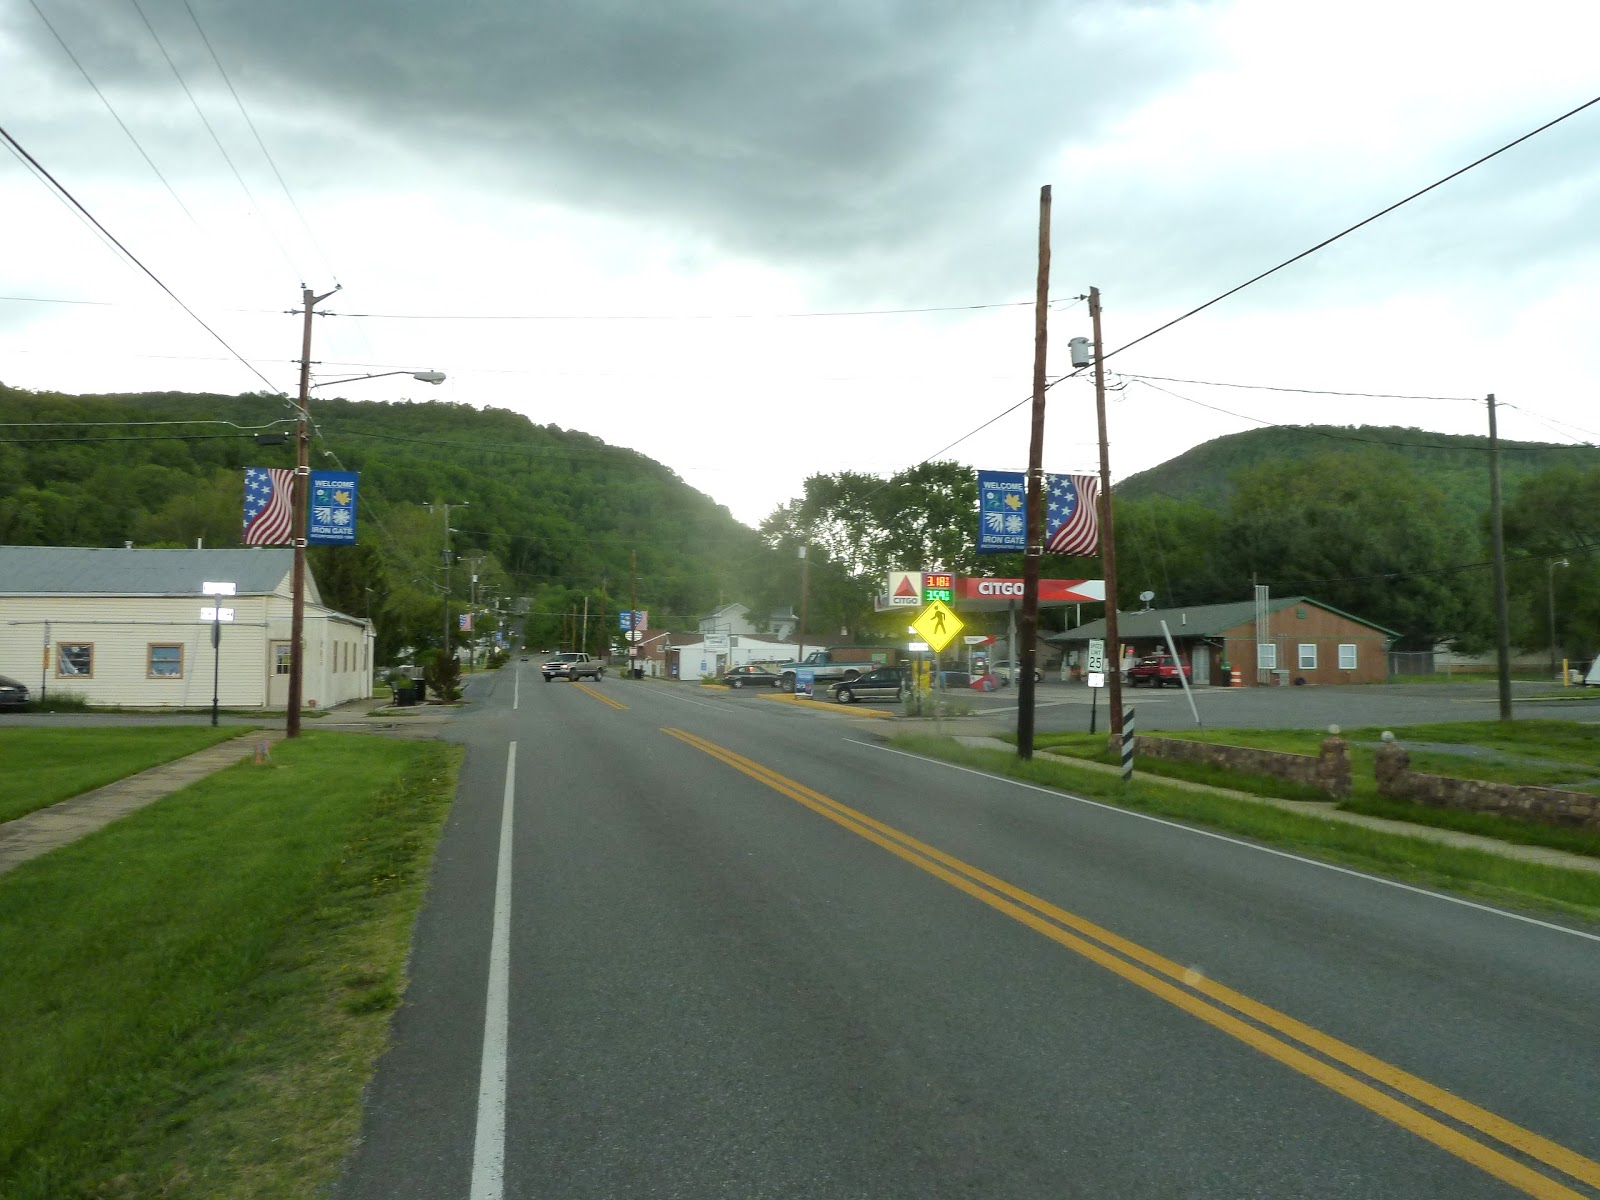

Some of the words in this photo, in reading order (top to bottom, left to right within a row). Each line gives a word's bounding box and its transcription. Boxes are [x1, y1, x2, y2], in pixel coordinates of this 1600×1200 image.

[314, 480, 355, 488] WELCOME
[983, 481, 1023, 490] WELCOME
[311, 526, 331, 534] IRON
[332, 527, 353, 535] GATE
[1004, 536, 1025, 544] GATE
[977, 582, 1024, 595] CITGO
[1089, 656, 1102, 669] 25
